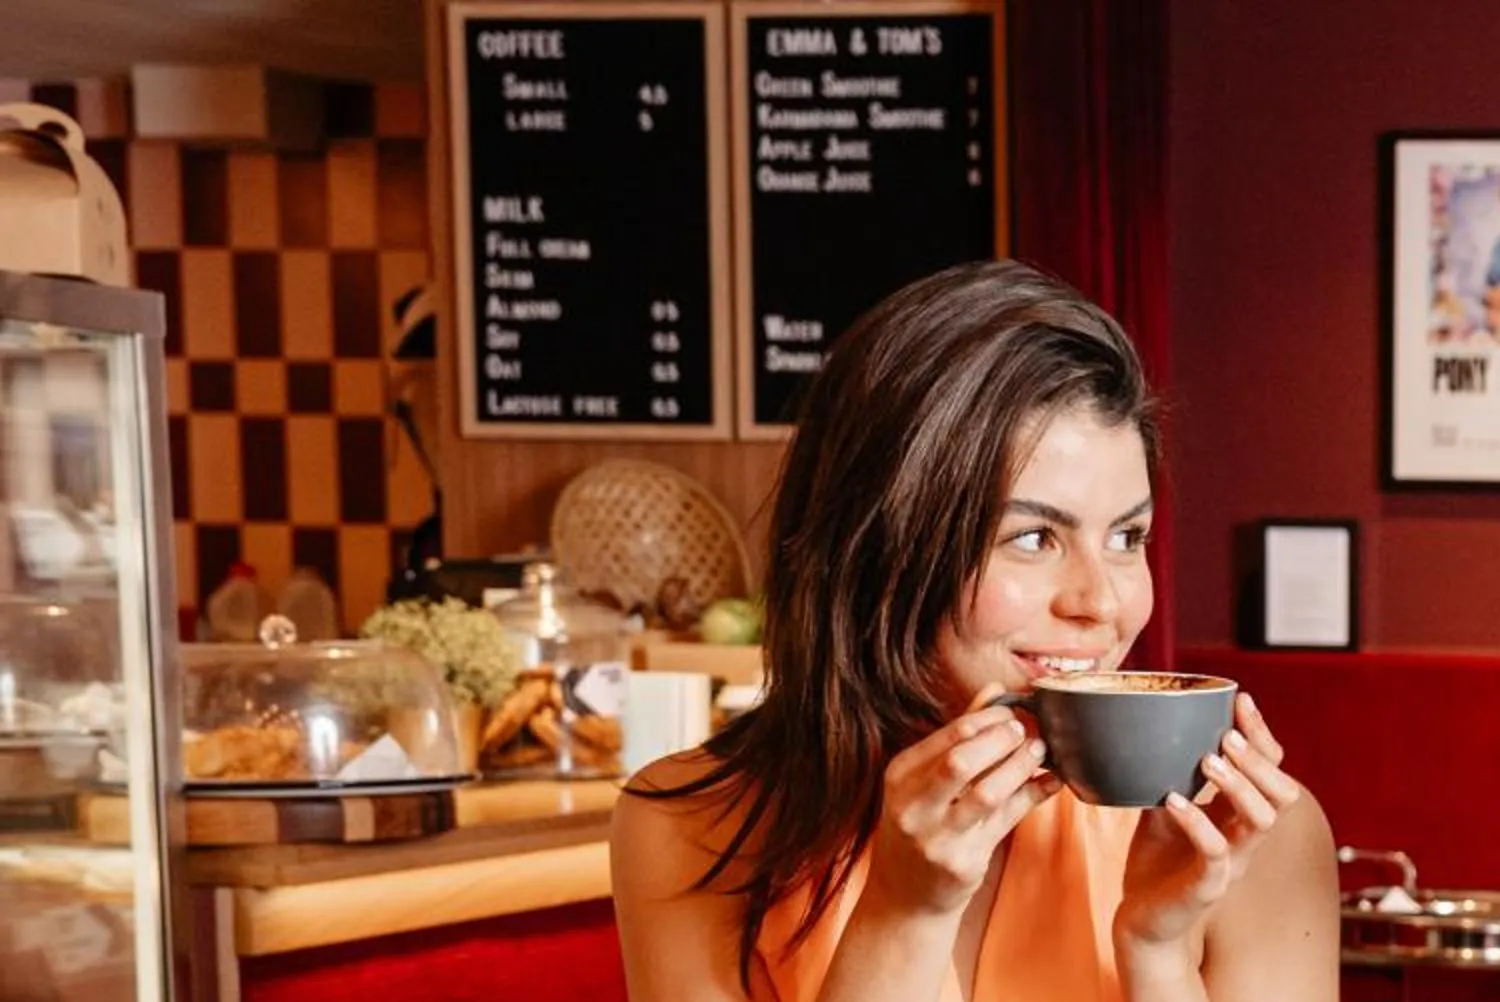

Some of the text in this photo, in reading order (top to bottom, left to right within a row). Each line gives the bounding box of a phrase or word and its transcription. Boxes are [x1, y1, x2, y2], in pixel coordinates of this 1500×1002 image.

[477, 30, 564, 58] COFFEE
[766, 26, 942, 56] EMMA & TOM'S
[506, 111, 565, 131] LARGE
[483, 197, 544, 223] MILK
[1433, 357, 1487, 393] PONY
